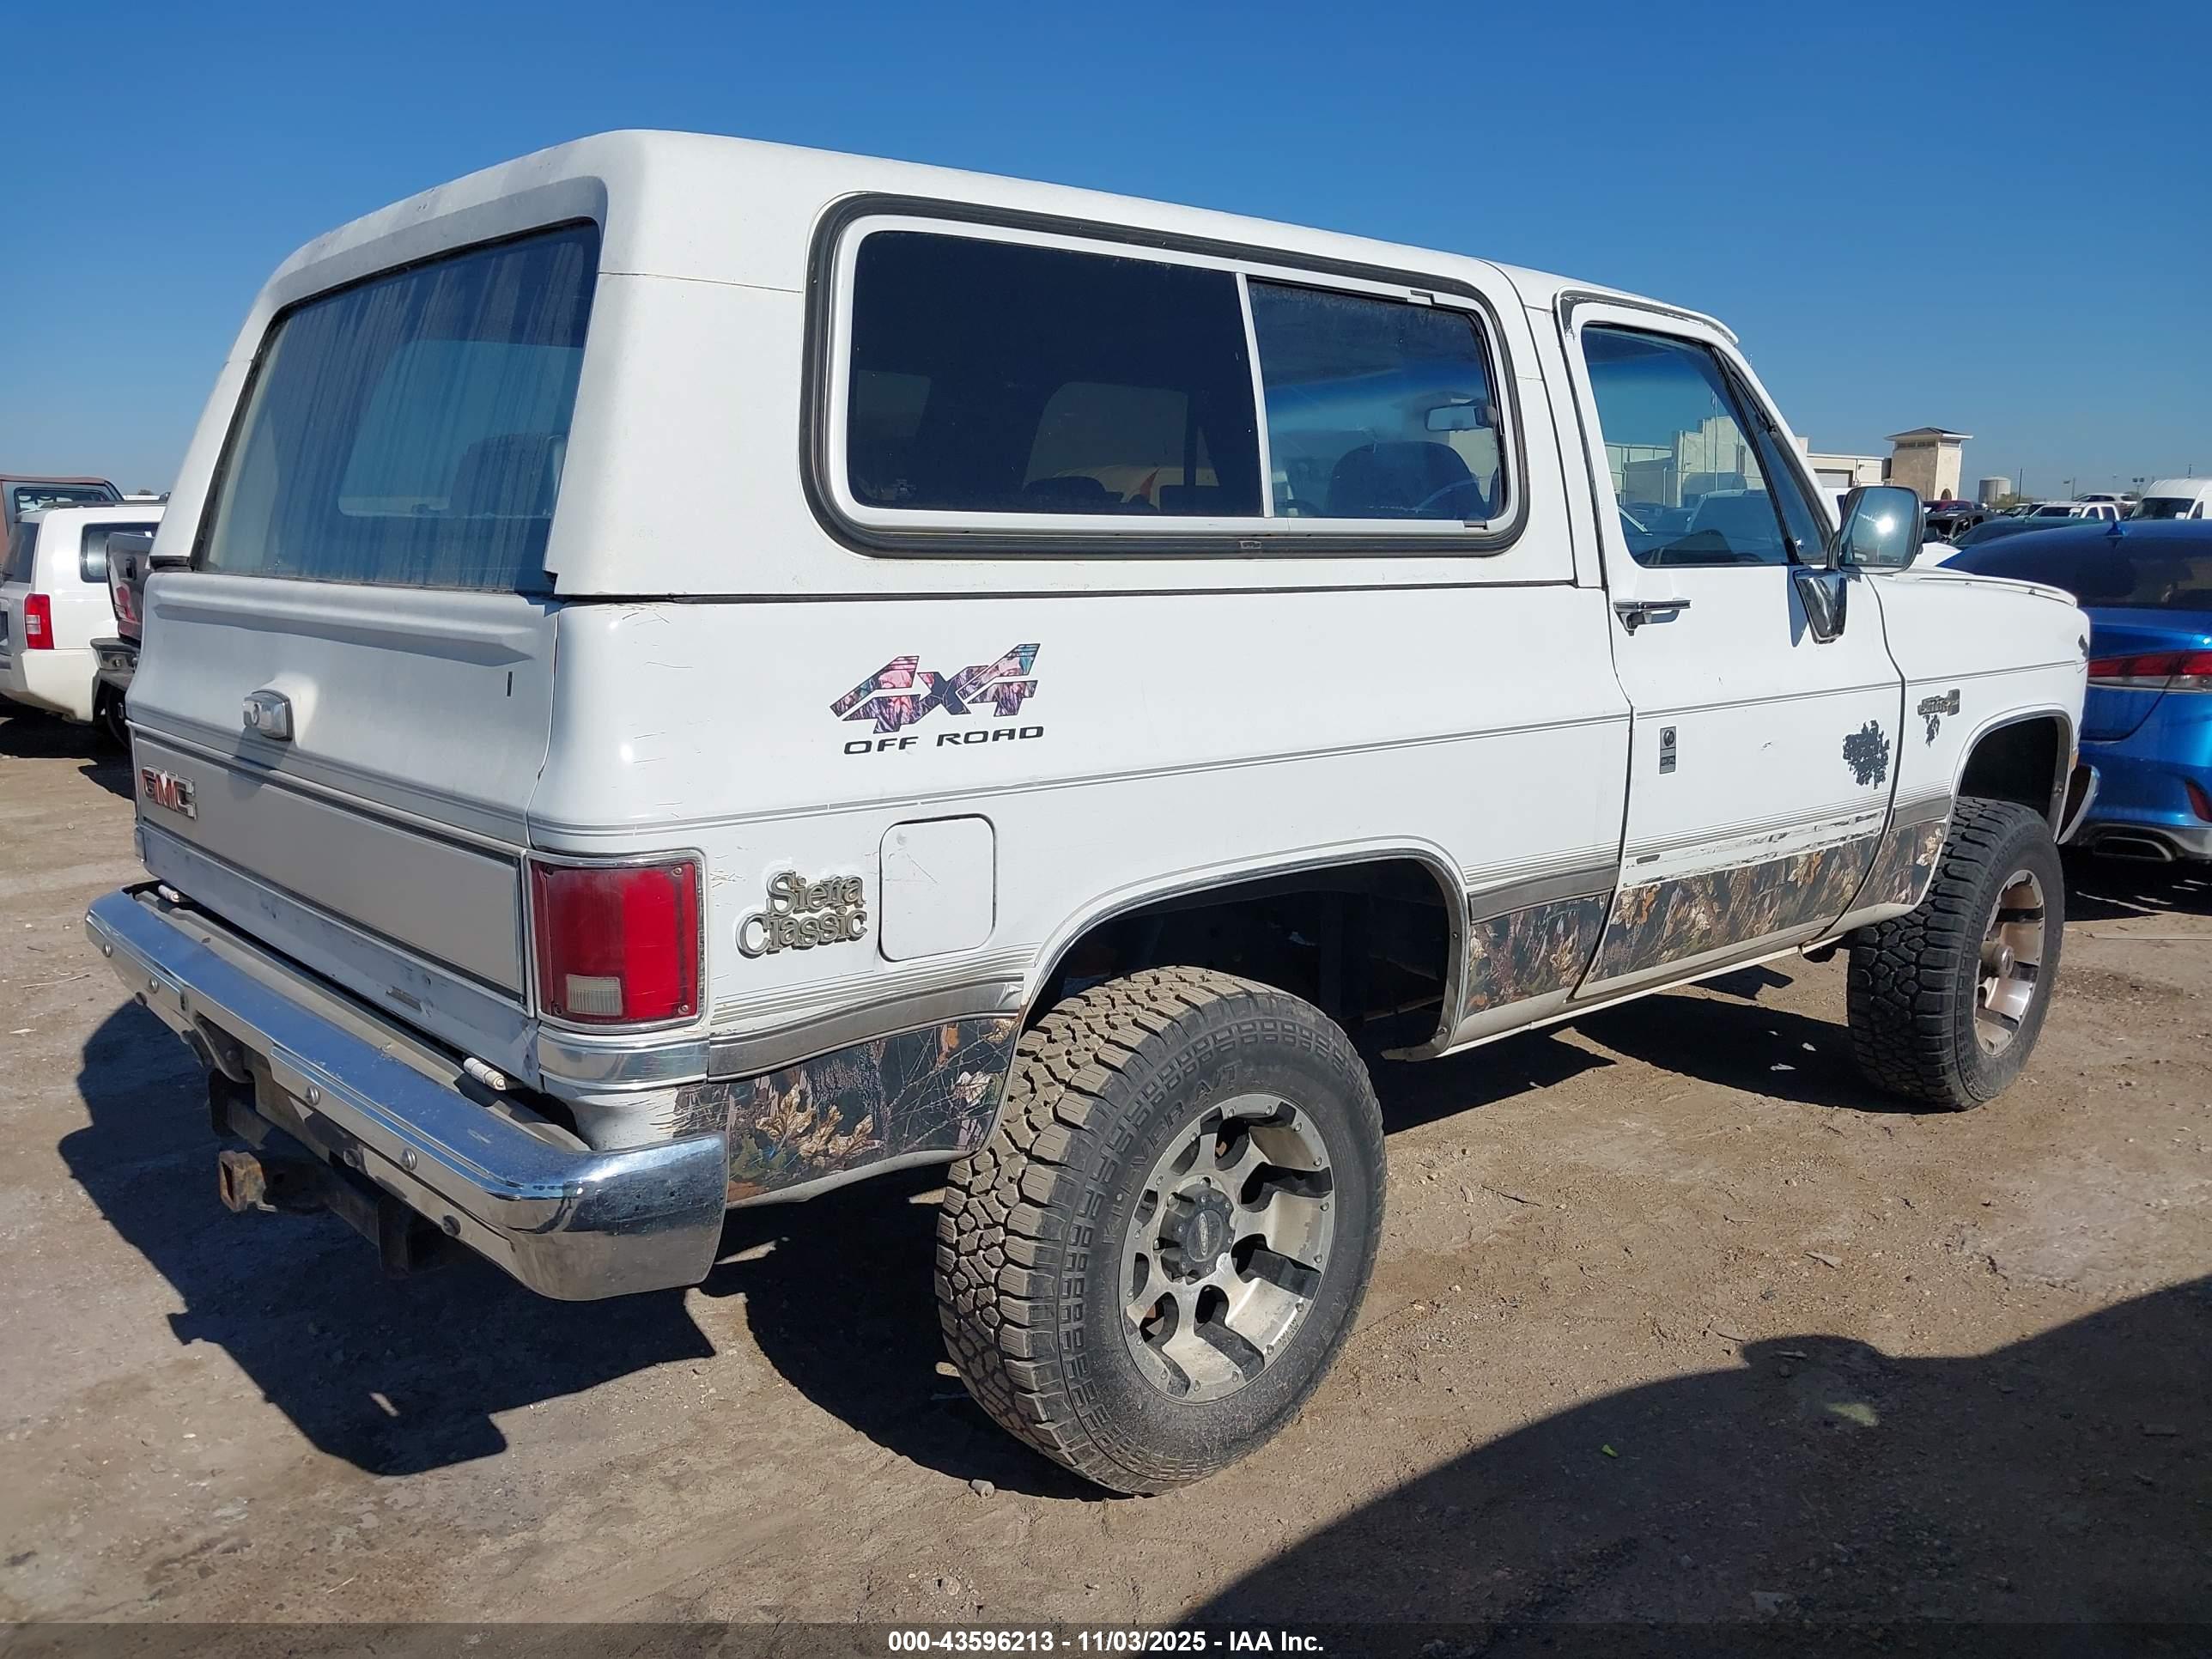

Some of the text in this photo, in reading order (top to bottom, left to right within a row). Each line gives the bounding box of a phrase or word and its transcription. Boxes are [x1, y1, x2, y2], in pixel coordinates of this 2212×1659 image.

[843, 726, 1044, 755] OFF ROAD
[142, 764, 196, 820] GMC
[766, 870, 866, 918] Sierra
[736, 910, 868, 959] Classic
